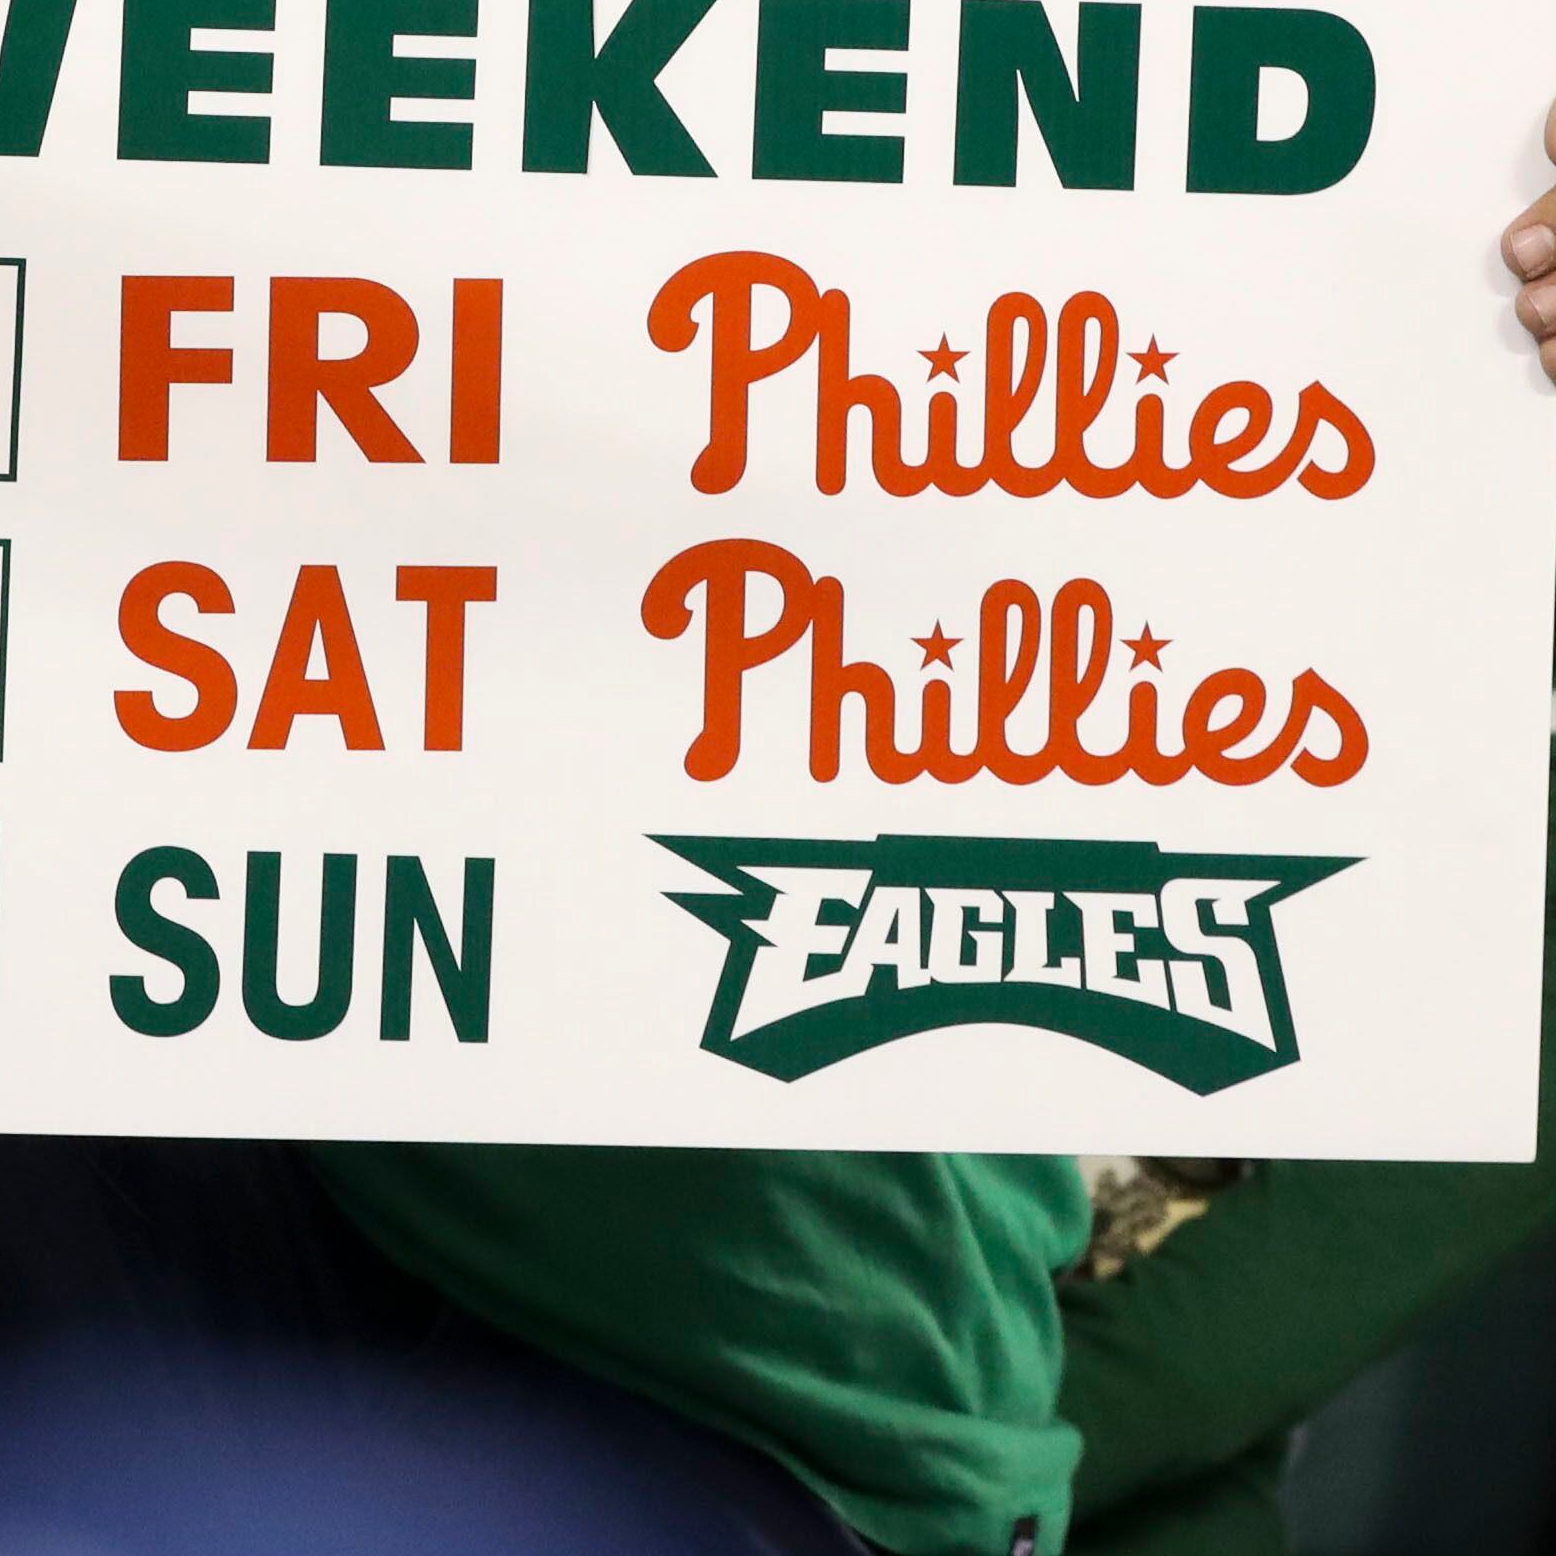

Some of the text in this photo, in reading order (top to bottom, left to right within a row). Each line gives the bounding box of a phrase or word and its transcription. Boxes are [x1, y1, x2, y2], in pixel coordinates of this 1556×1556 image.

[116, 249, 1377, 502] FRI Phillies
[112, 537, 1371, 789] SAT Phillies
[111, 845, 1284, 1055] SUN EAGLES
